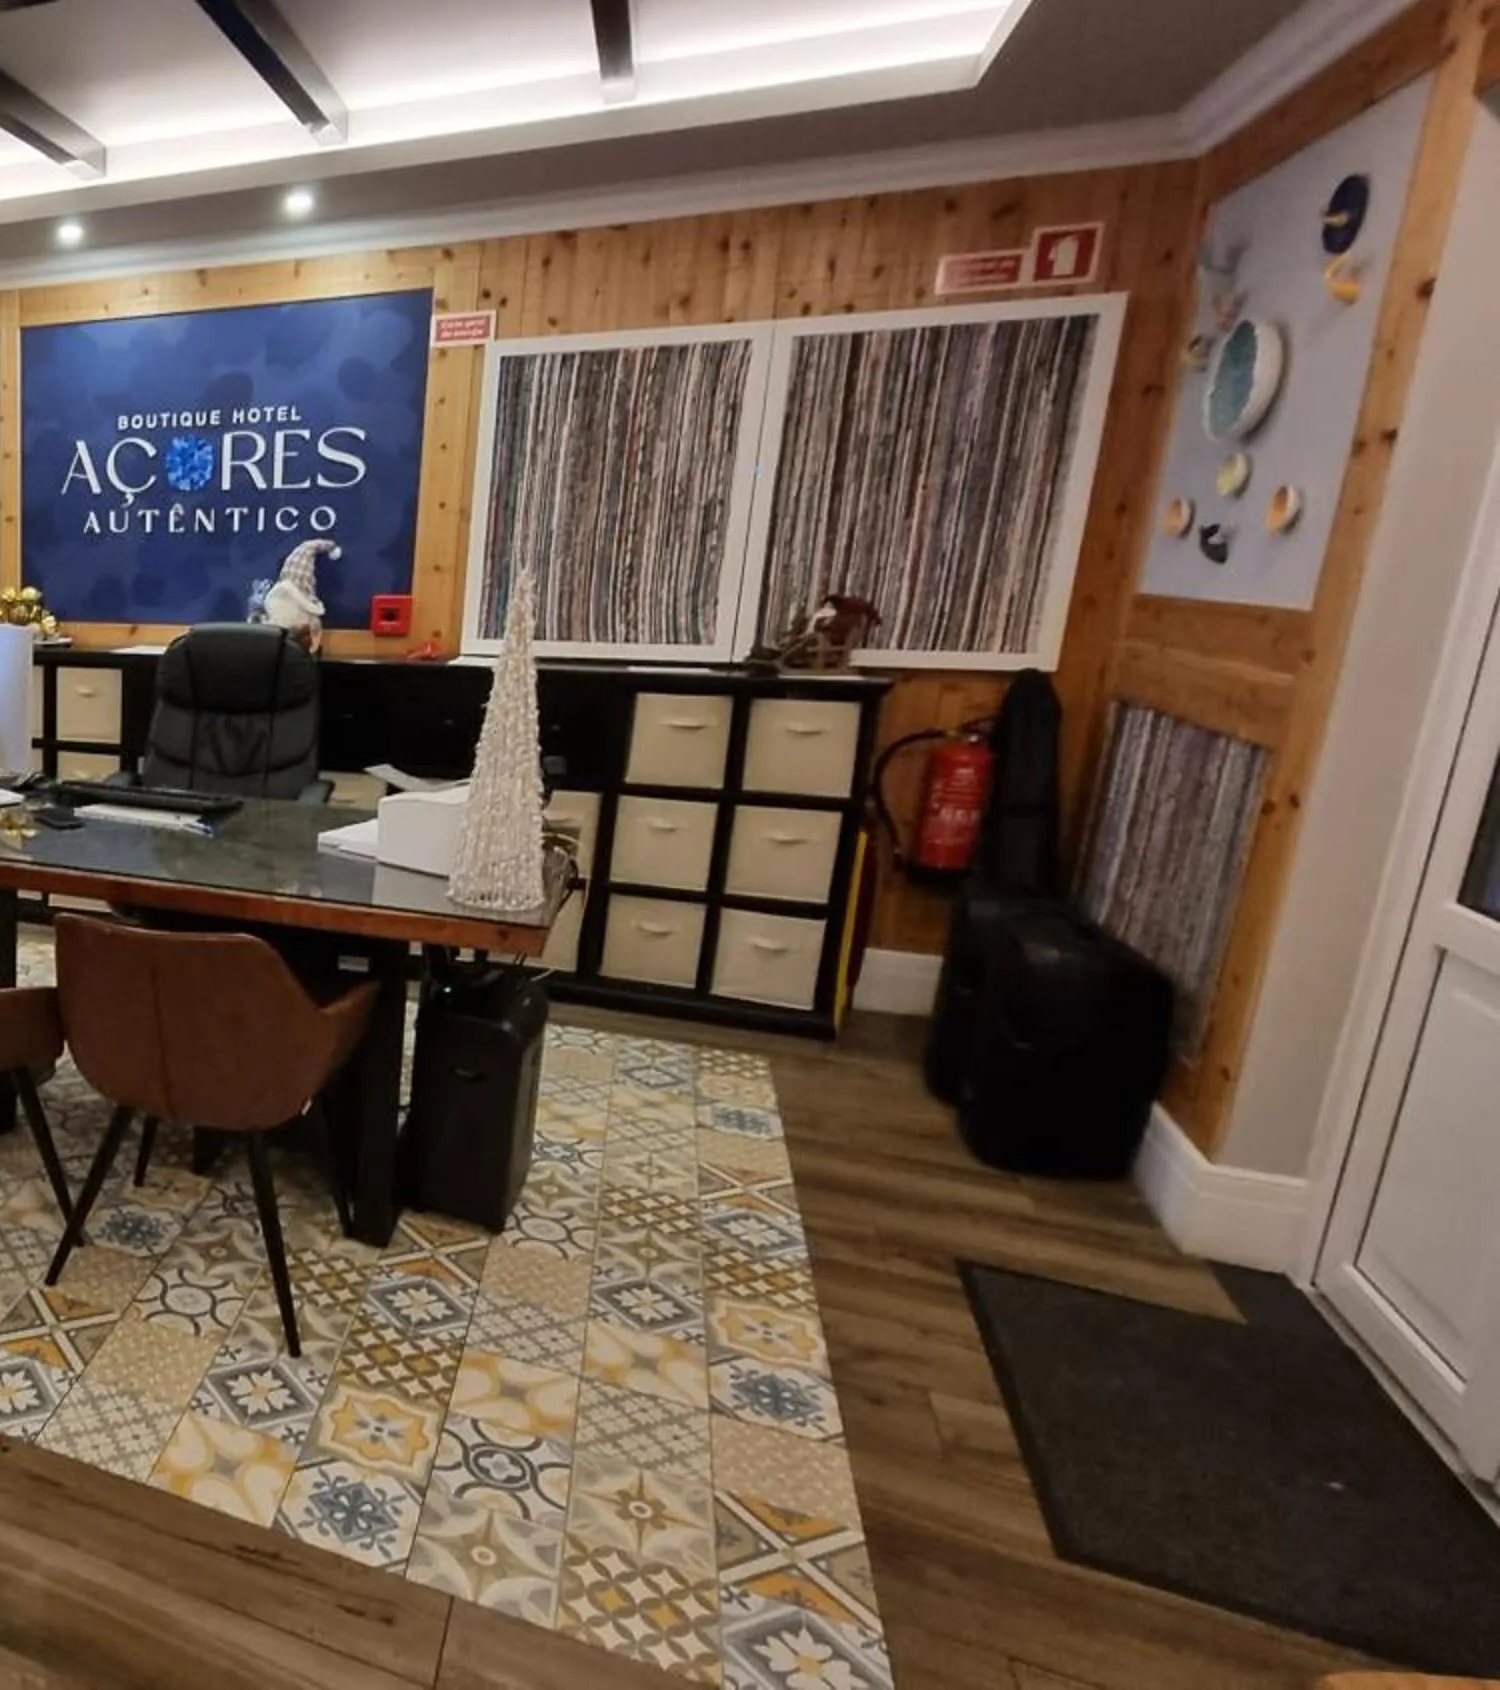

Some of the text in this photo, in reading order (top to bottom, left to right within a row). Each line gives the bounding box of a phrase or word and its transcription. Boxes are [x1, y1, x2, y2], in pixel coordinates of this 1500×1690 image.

[117, 405, 301, 430] BOUTIQUE HOTEL
[61, 426, 367, 508] AÇORES
[83, 503, 338, 534] AUTÊNTICO
